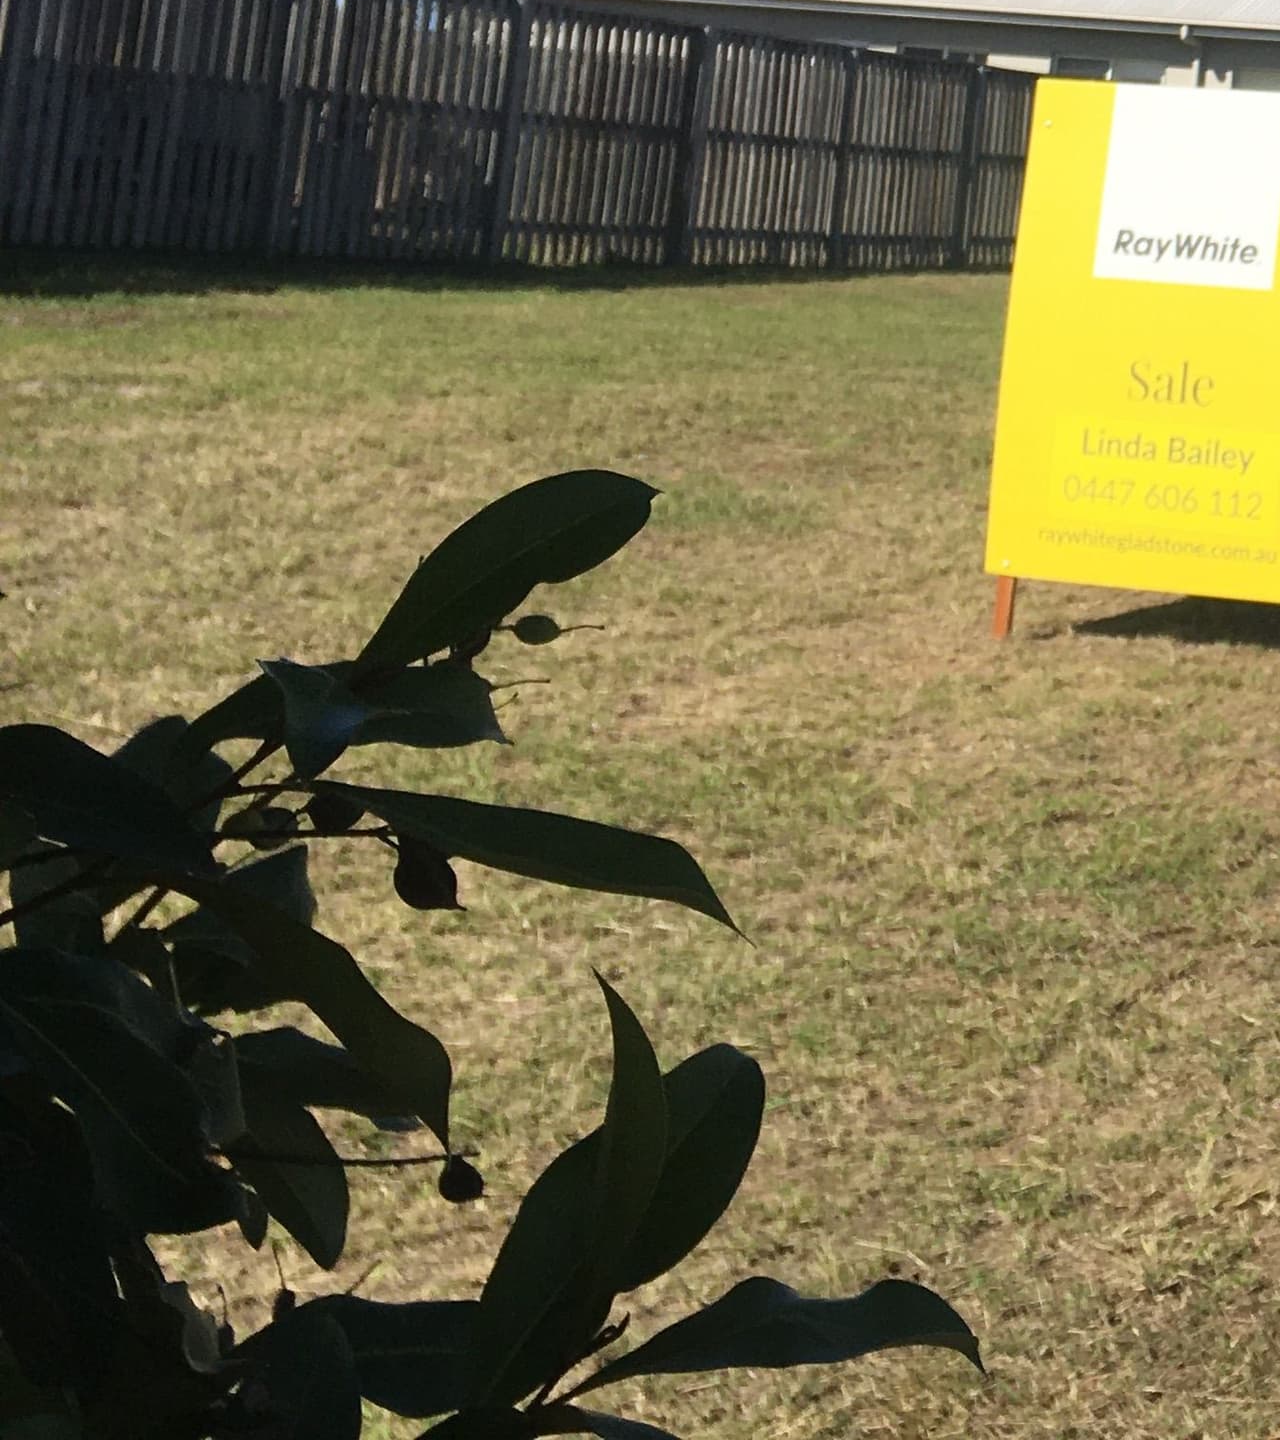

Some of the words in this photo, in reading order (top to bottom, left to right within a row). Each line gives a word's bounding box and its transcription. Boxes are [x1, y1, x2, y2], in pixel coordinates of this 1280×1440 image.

[1128, 360, 1215, 408] Sale
[1081, 427, 1158, 461] Linda
[1167, 436, 1255, 474] Bailey
[1063, 477, 1137, 506] 0447
[1144, 484, 1199, 515] 606
[1210, 490, 1264, 520] 112
